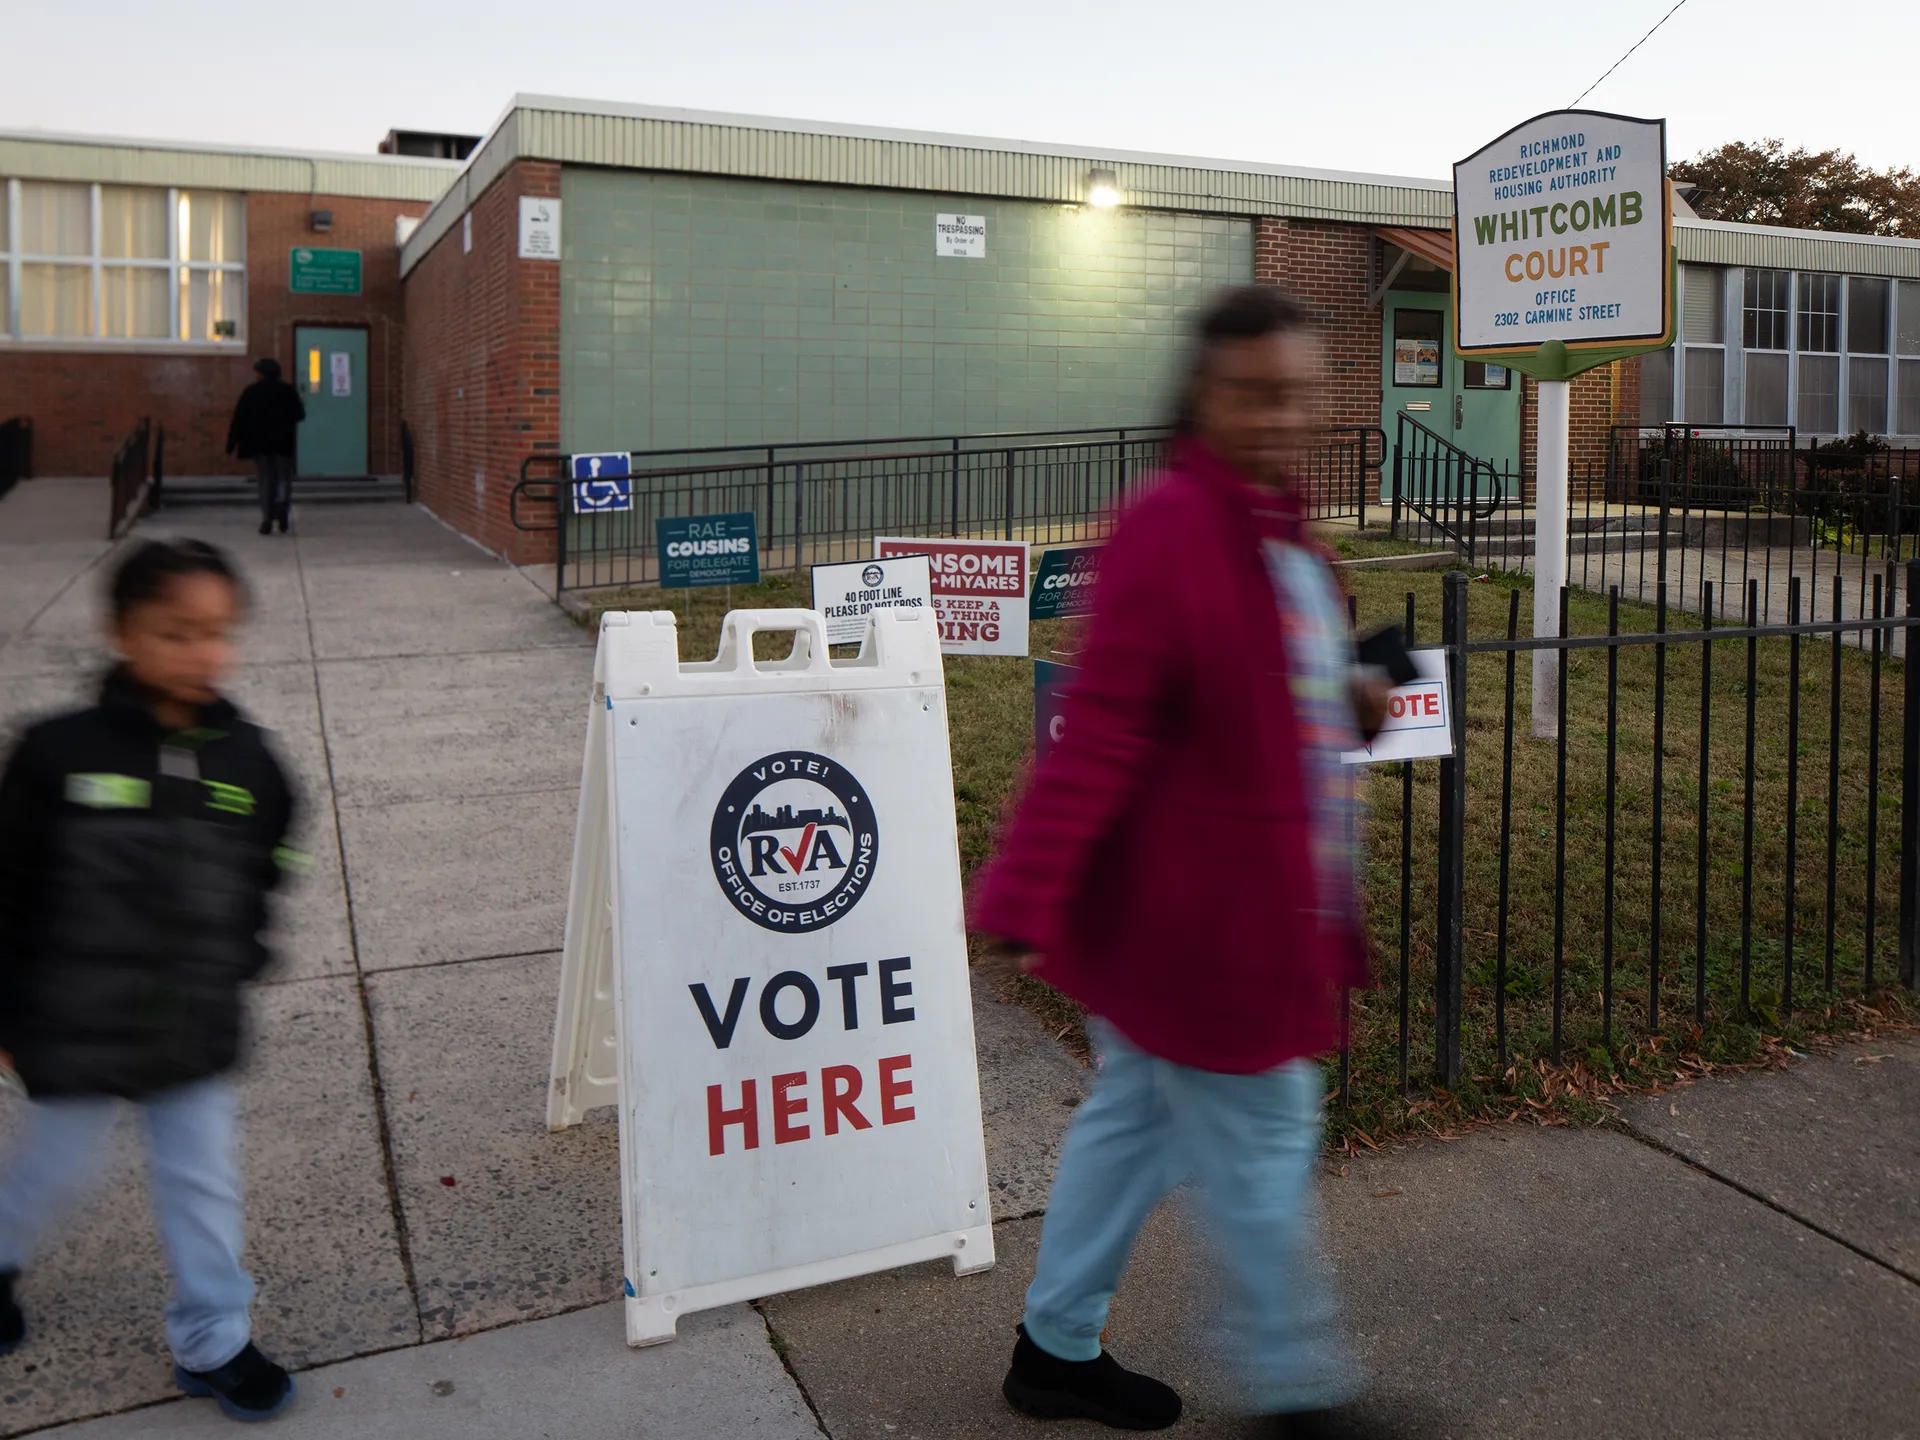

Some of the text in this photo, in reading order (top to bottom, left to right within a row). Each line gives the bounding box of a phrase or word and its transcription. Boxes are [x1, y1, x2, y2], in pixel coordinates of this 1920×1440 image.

[1521, 133, 1585, 158] RICHMOND
[1490, 145, 1621, 183] REDEVELOPMENT AND
[1495, 166, 1617, 200] HOUSING AUTHORITY
[956, 215, 966, 225] NO
[1474, 191, 1643, 245] WHITCOMB
[938, 224, 984, 235] TRESPASSING
[1505, 241, 1610, 282] COURT
[1536, 289, 1576, 305] OFFICE
[1495, 303, 1621, 327] 2302 CARMINE STREET
[689, 521, 726, 539] RAE
[667, 537, 750, 557] COUSINS
[668, 556, 750, 570] FOR DELEGATE
[886, 551, 1019, 575] NSOME
[689, 568, 731, 578] DEMOCRAT
[940, 574, 1020, 590] MIYARES
[845, 587, 902, 603] 40 FOOT LINE
[1038, 592, 1061, 602] FOR
[825, 604, 858, 618] PLEASE
[946, 600, 984, 610] KEEP
[988, 601, 1000, 610] A
[951, 611, 1000, 621] THING
[1388, 693, 1440, 719] OTE
[752, 759, 830, 782] VOTE!
[718, 833, 872, 925] OFFICE OF ELECTIONS
[778, 880, 820, 892] EST.1737
[688, 956, 916, 1050] VOTE
[707, 1054, 916, 1156] HERE
